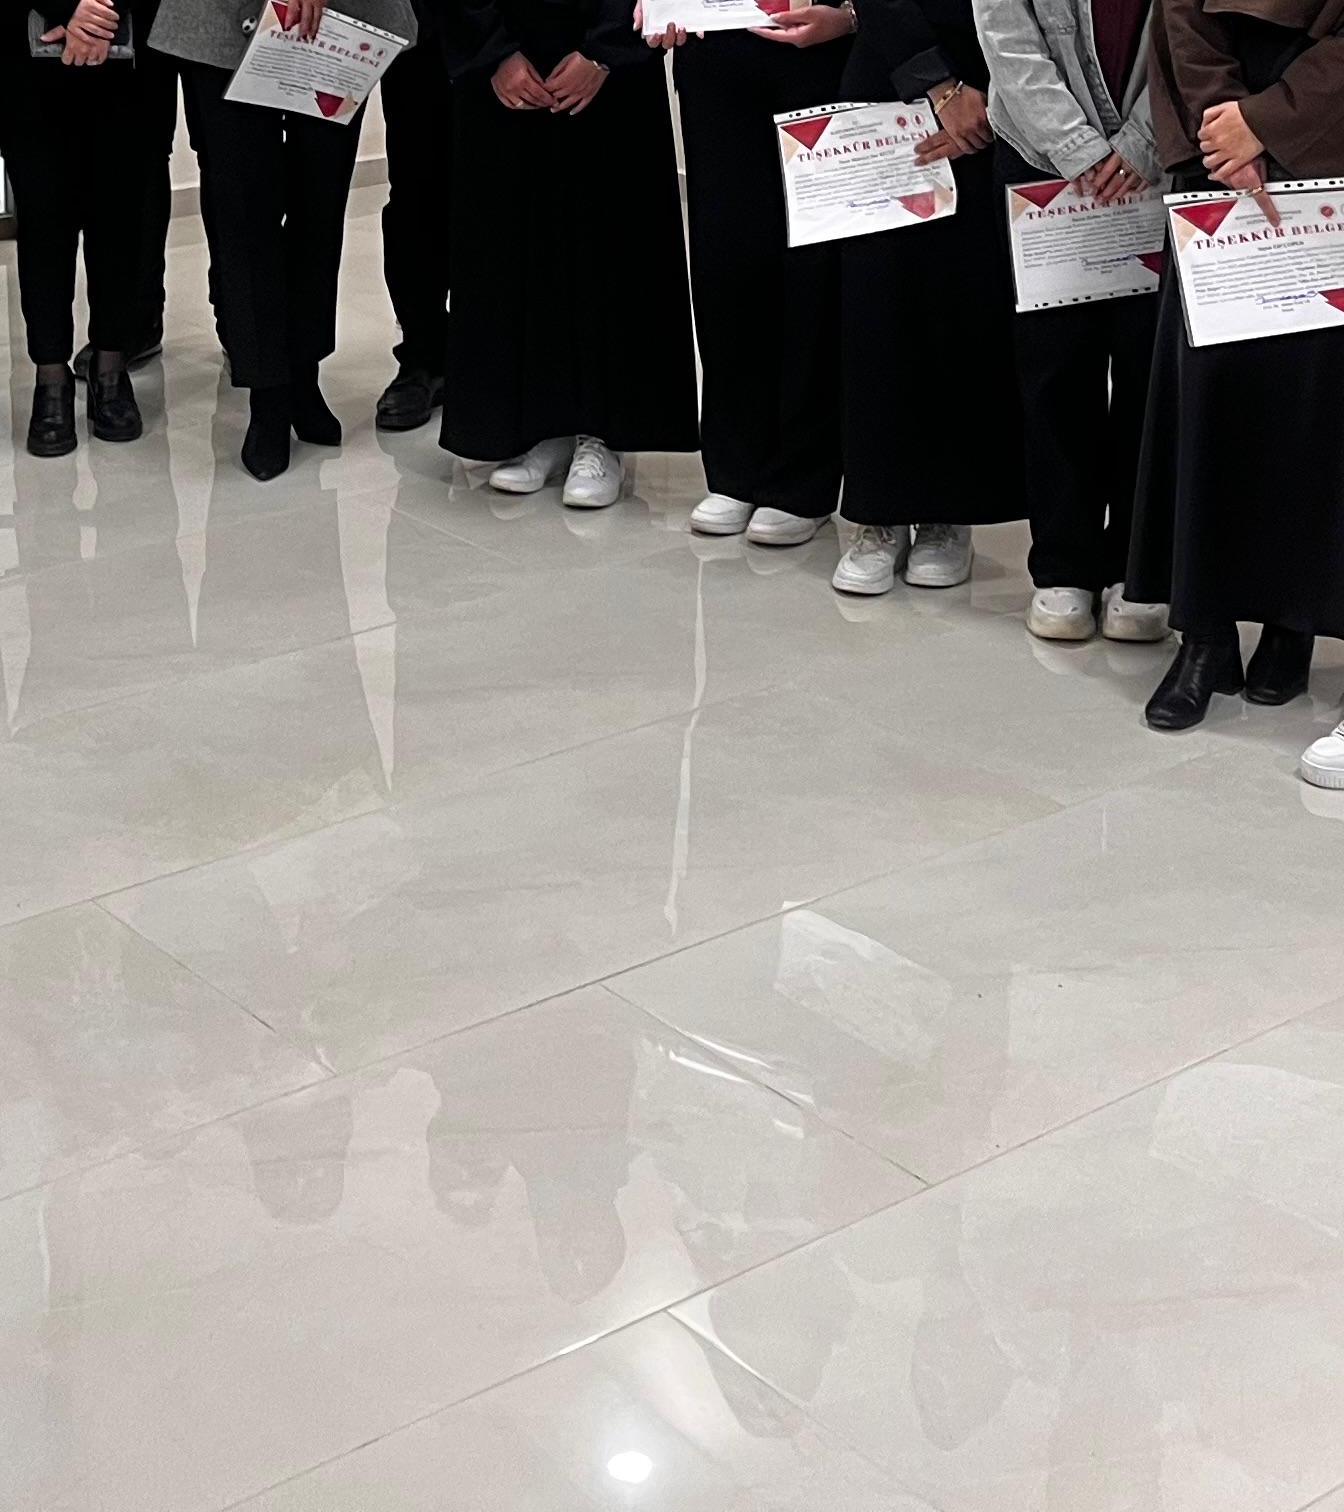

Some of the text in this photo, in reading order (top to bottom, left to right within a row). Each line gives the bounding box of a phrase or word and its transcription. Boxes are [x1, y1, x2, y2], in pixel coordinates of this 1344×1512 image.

[328, 43, 380, 68] BELGESİ
[797, 139, 871, 163] TEŞEKKÜR
[1193, 226, 1286, 250] TEŞEKKÜR
